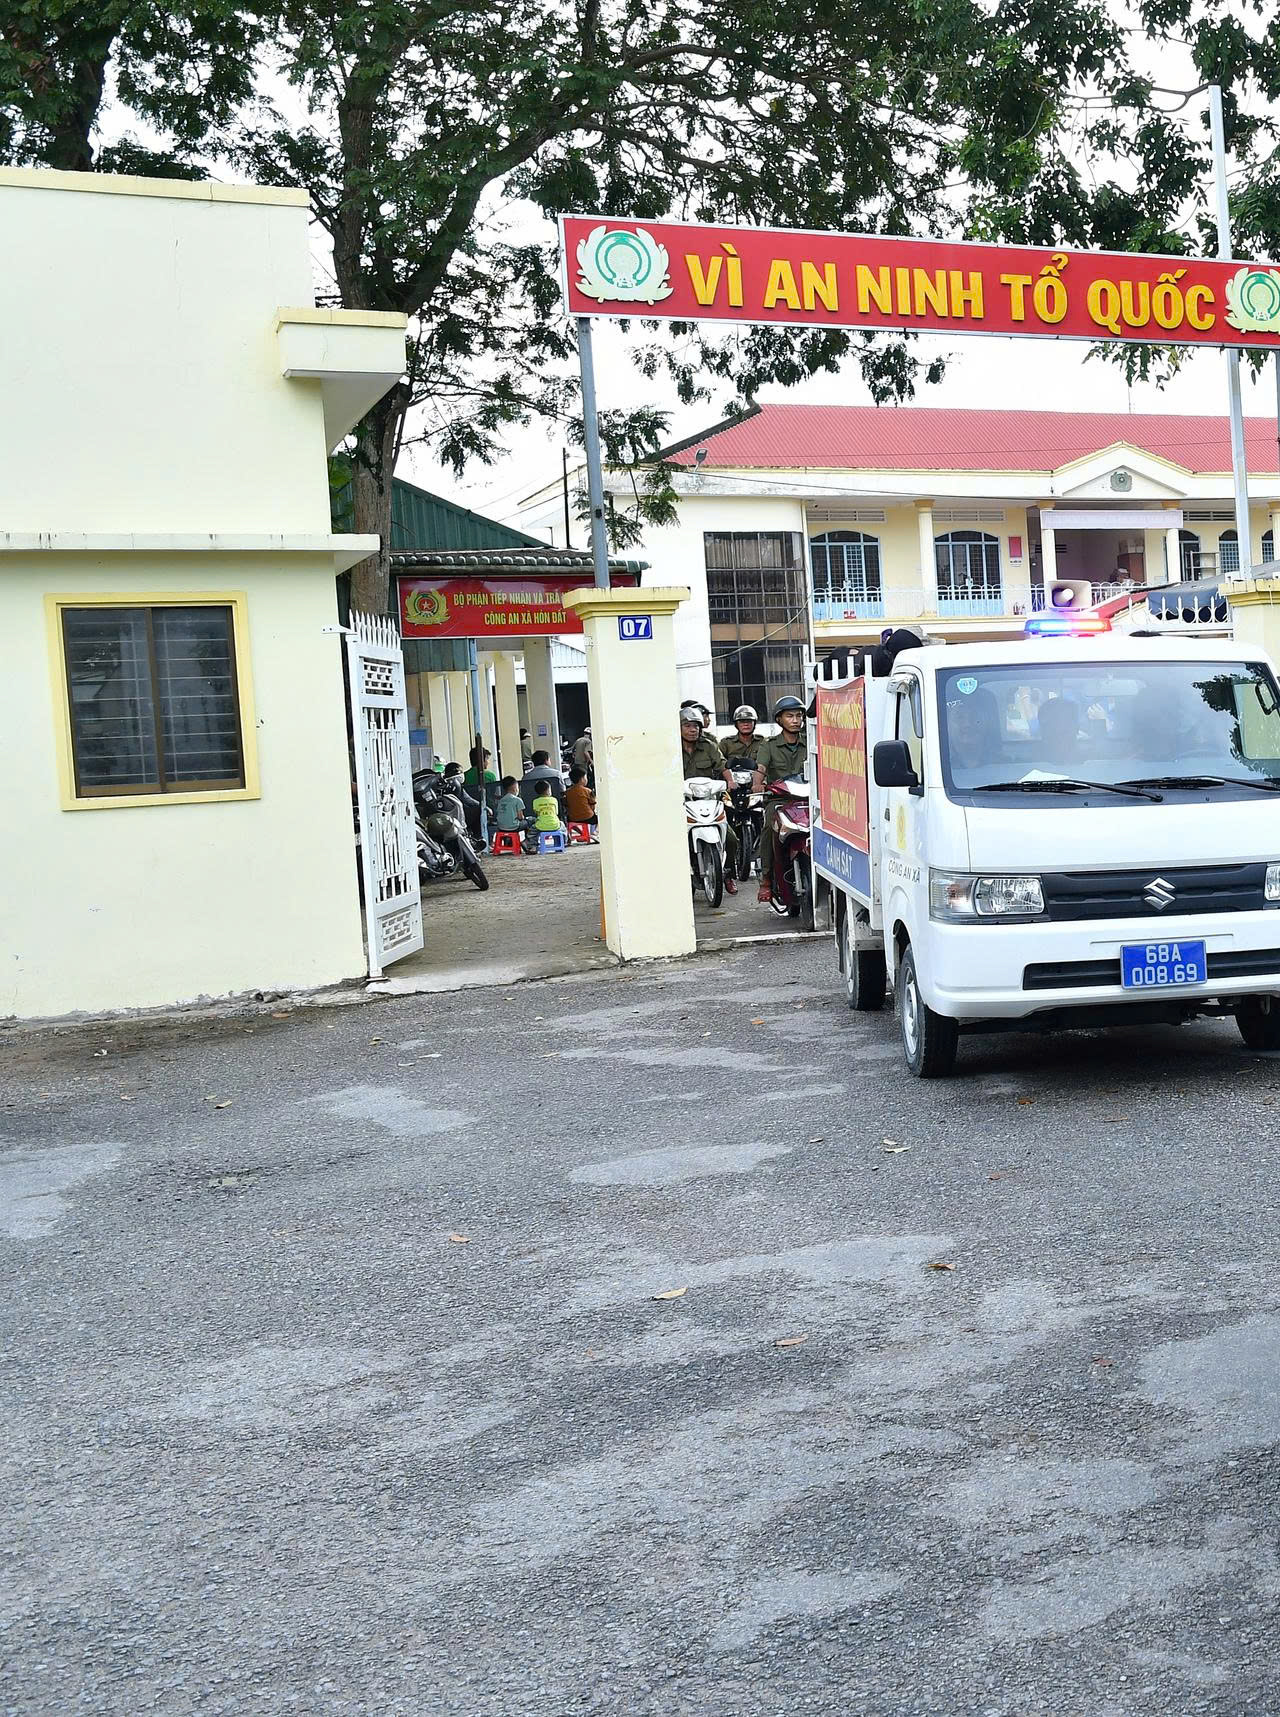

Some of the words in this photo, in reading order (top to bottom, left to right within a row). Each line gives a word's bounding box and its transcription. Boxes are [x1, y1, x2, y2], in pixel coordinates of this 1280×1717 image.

[685, 243, 744, 308] VÌ
[763, 259, 839, 313] AN
[856, 264, 985, 320] NINH
[1000, 253, 1070, 325] TỔ
[1087, 268, 1216, 335] QUỐC
[453, 591, 464, 608] BỘ
[466, 590, 489, 608] PHẬN
[490, 588, 507, 605] TIẾP
[509, 590, 530, 607] NHẬN
[533, 589, 544, 605] VÀ
[484, 610, 507, 625] CÔNG
[508, 611, 520, 625] AN
[521, 609, 533, 624] XÃ
[622, 618, 648, 637] 07
[826, 837, 841, 873] CẢNH
[841, 848, 853, 880] SÁT
[903, 866, 912, 880] AN
[1145, 944, 1182, 964] 68A
[1131, 963, 1198, 986] 008.69
